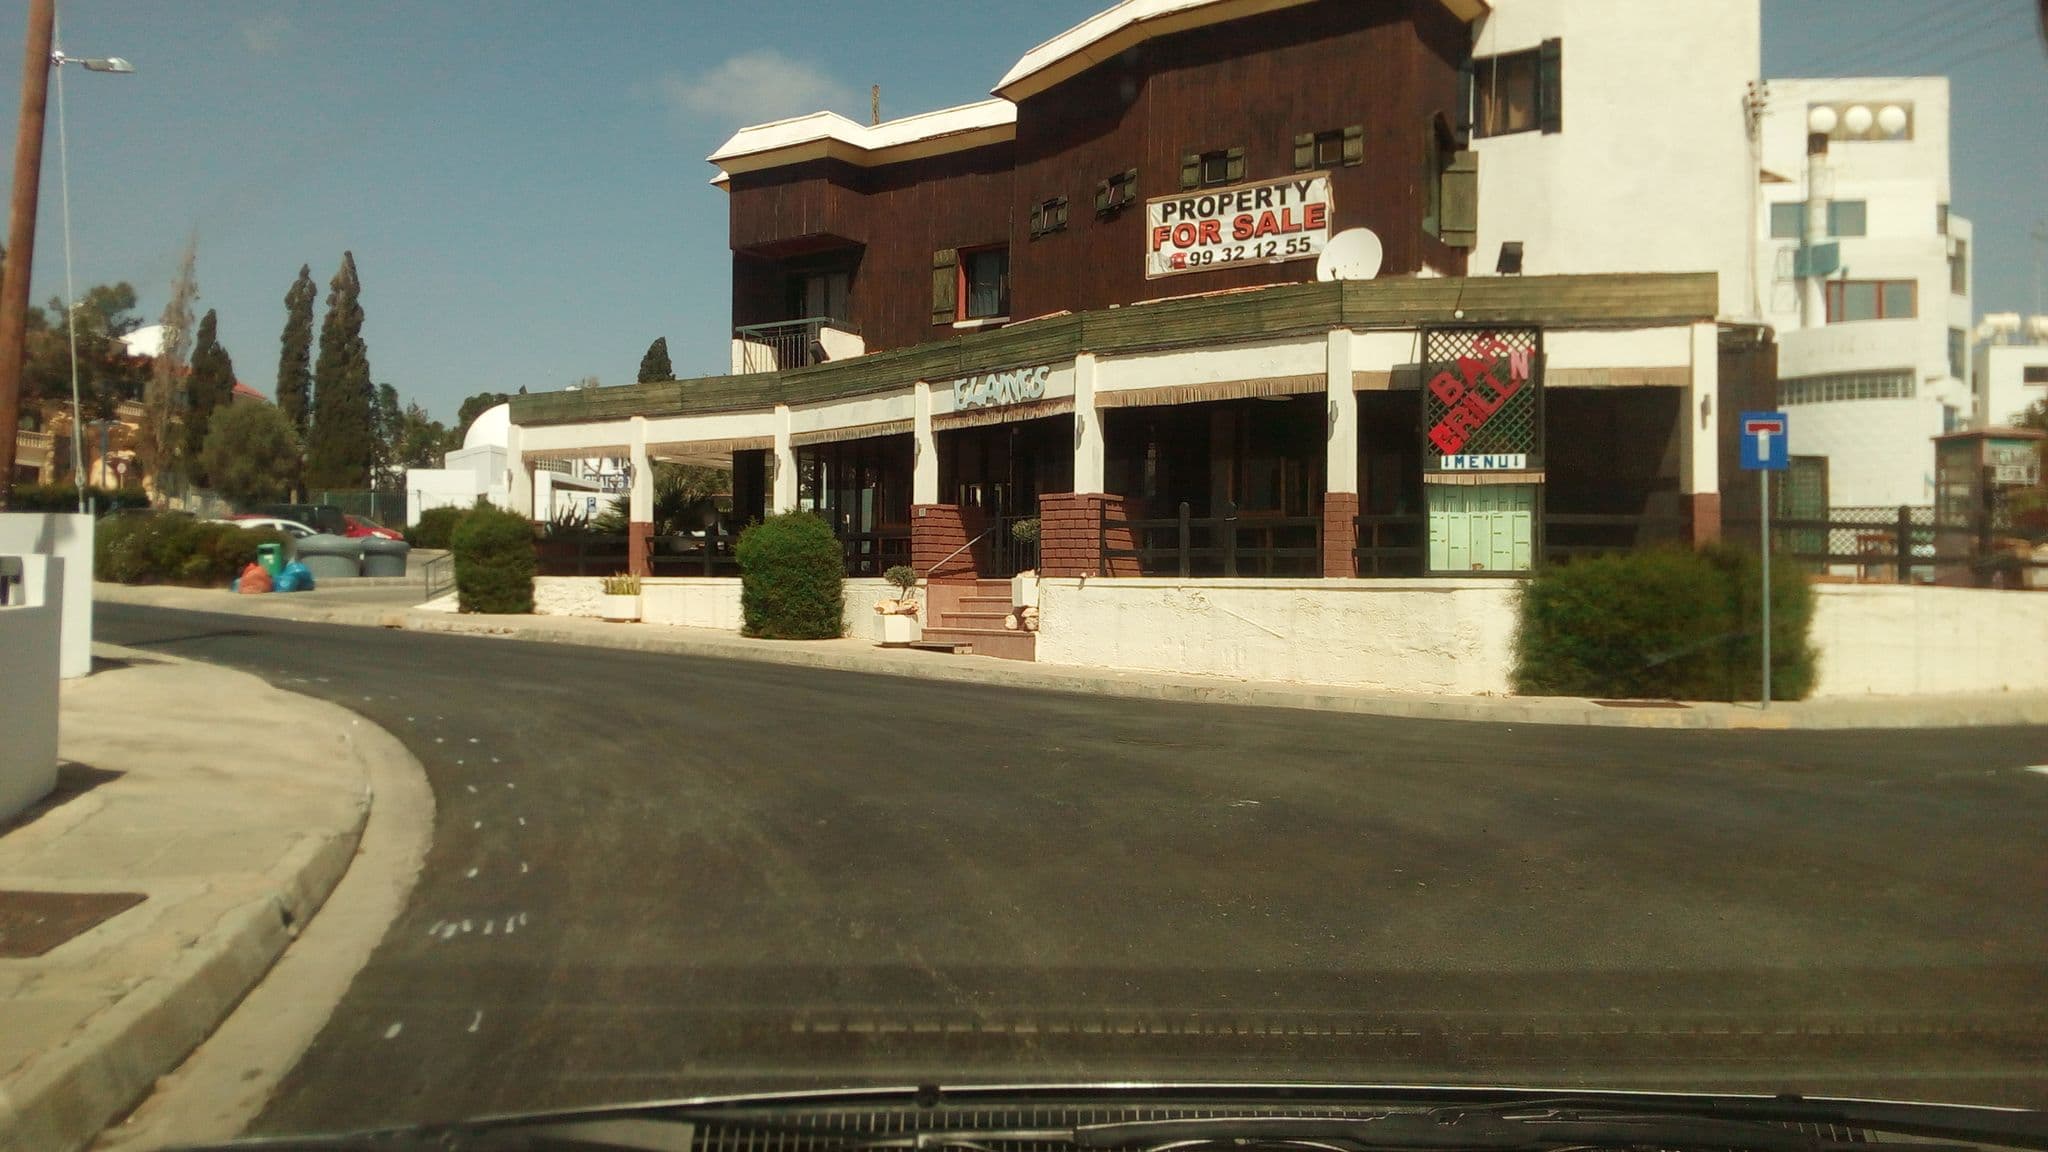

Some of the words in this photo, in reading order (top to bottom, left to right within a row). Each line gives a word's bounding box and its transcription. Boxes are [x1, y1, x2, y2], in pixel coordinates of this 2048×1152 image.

[1161, 180, 1314, 223] PROPERTY
[1152, 219, 1222, 252] FOR
[1232, 202, 1327, 241] SALE
[1189, 250, 1214, 267] 99
[1221, 246, 1245, 262] 32
[1253, 240, 1277, 258] 12
[1285, 236, 1311, 254] 55
[1428, 331, 1510, 407] BAR
[1428, 373, 1522, 456] GRILL
[1454, 455, 1509, 469] MENU
